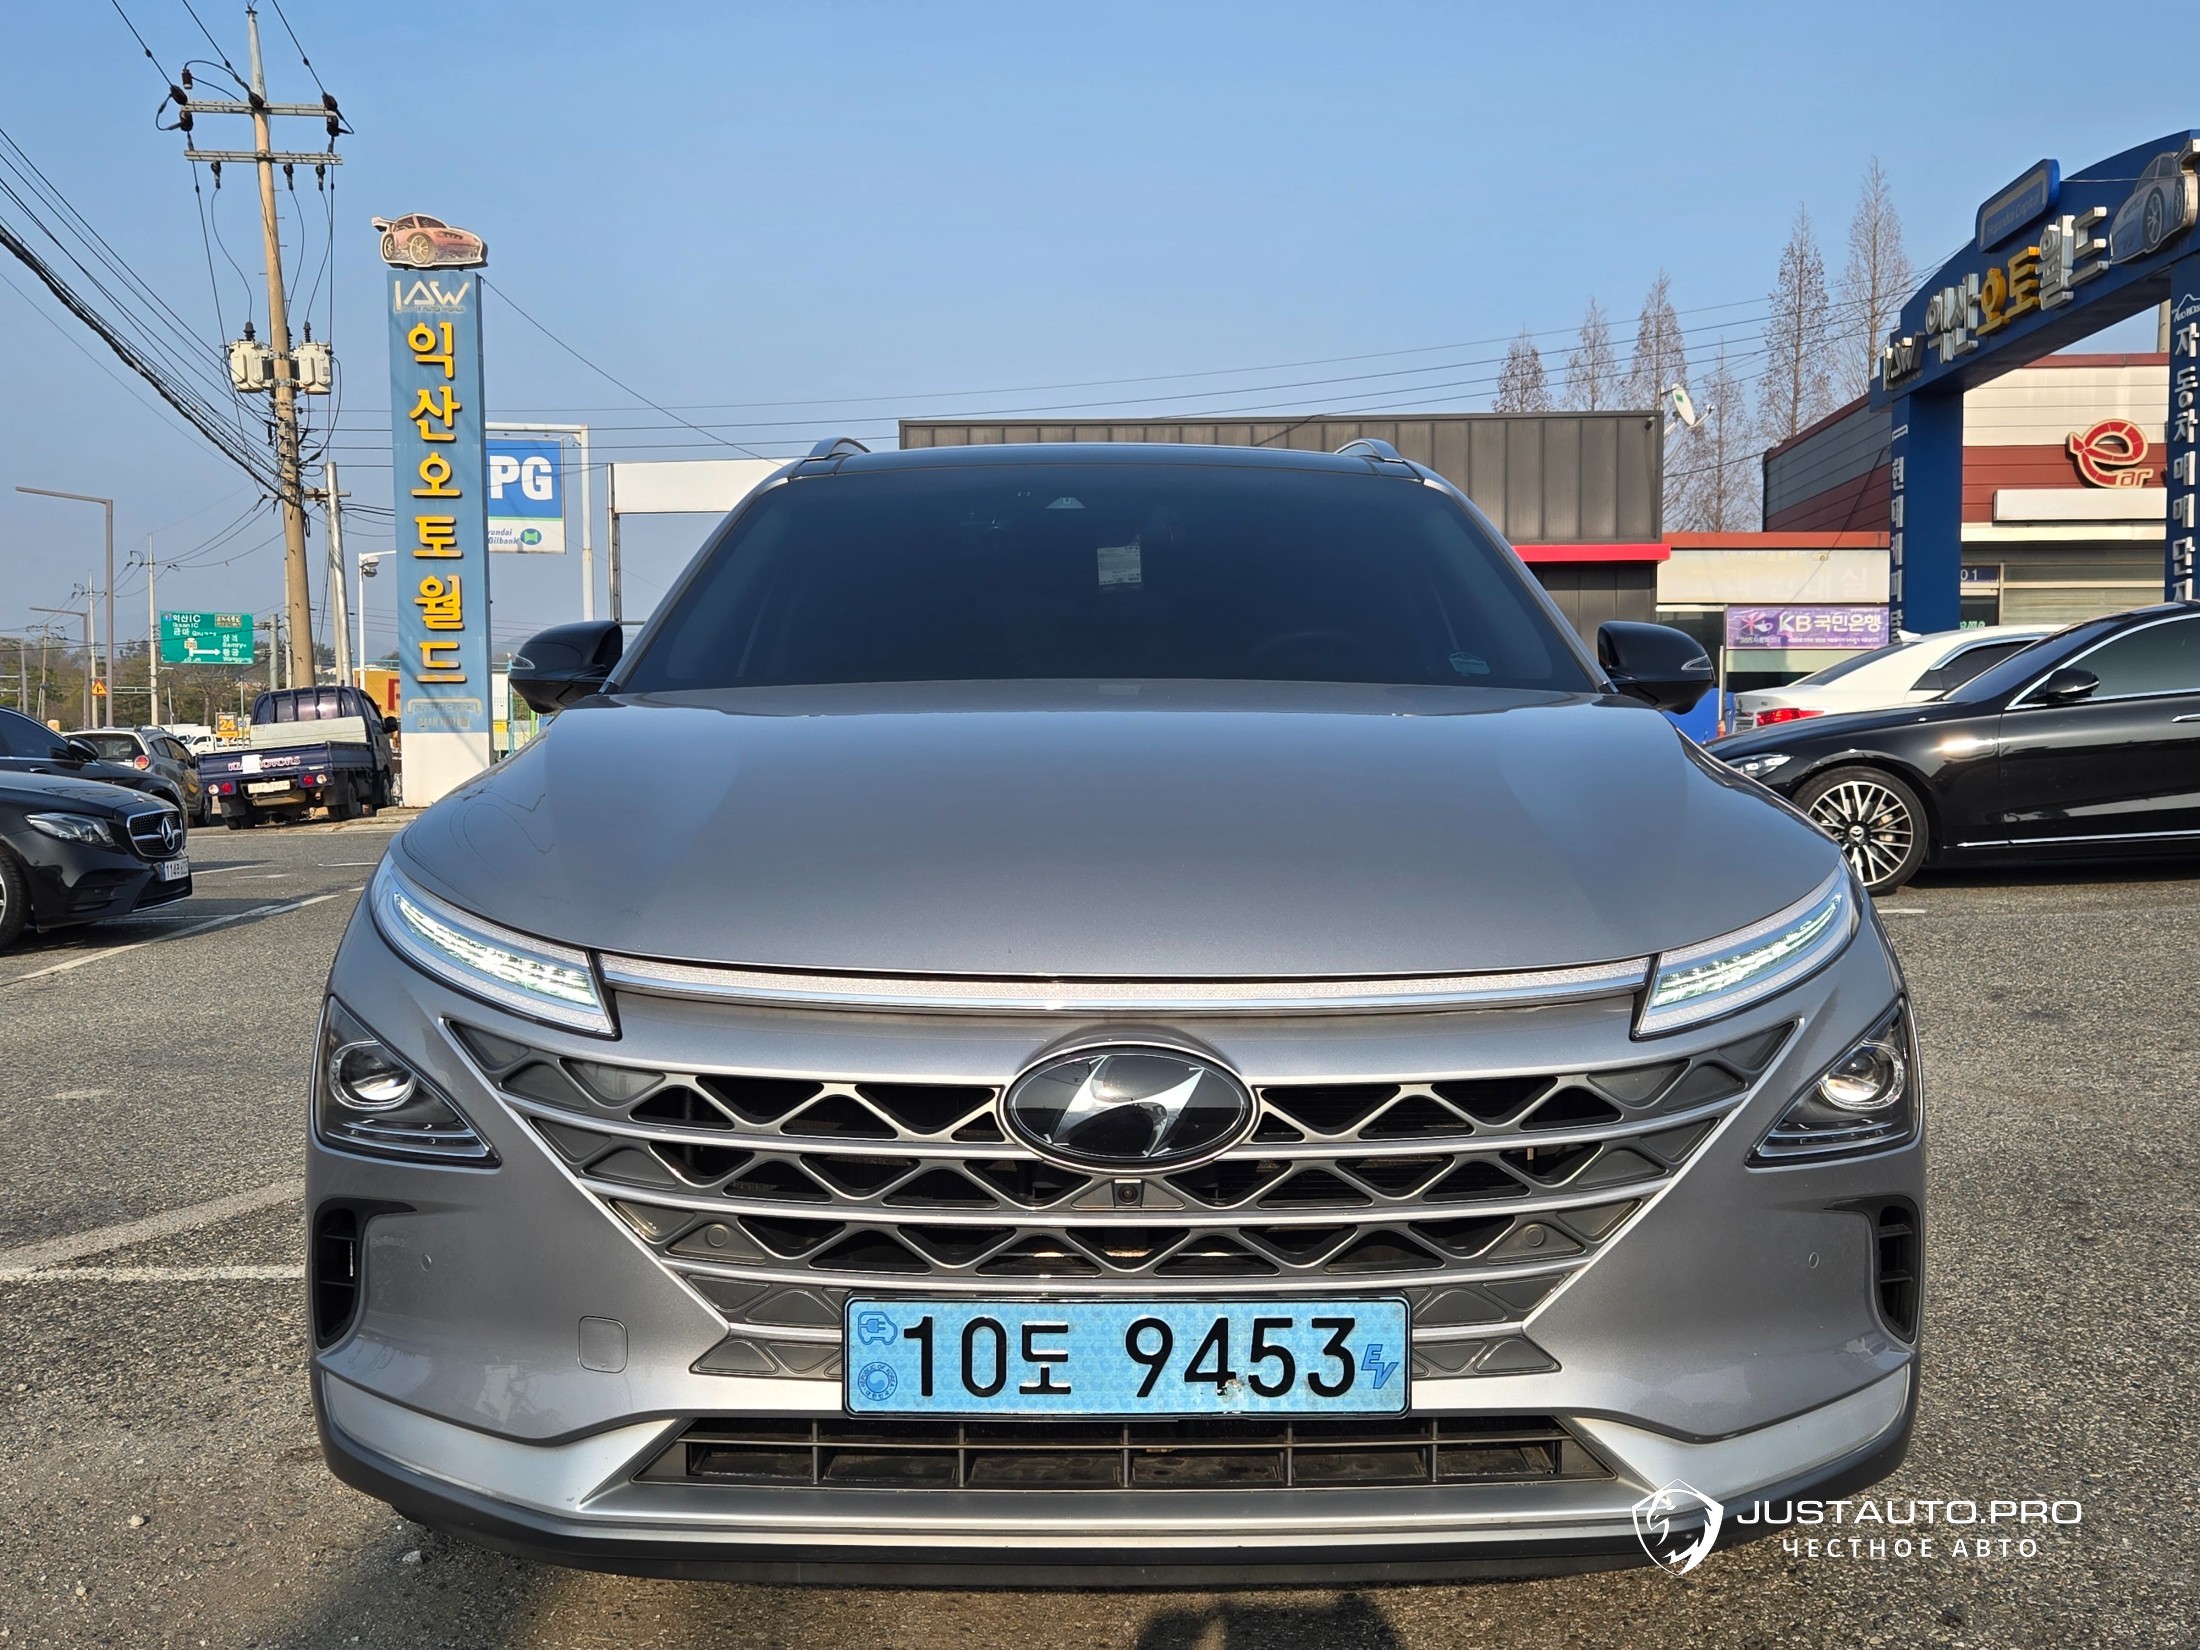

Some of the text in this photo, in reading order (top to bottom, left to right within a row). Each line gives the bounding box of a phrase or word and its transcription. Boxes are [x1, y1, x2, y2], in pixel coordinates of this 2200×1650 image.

[395, 281, 471, 311] IAW
[1926, 207, 2109, 363] 익산오토월드
[408, 322, 467, 683] 익산오토월드
[219, 720, 236, 730] 24
[904, 1315, 1357, 1399] 10도 9453
[1361, 1343, 1398, 1390] EV
